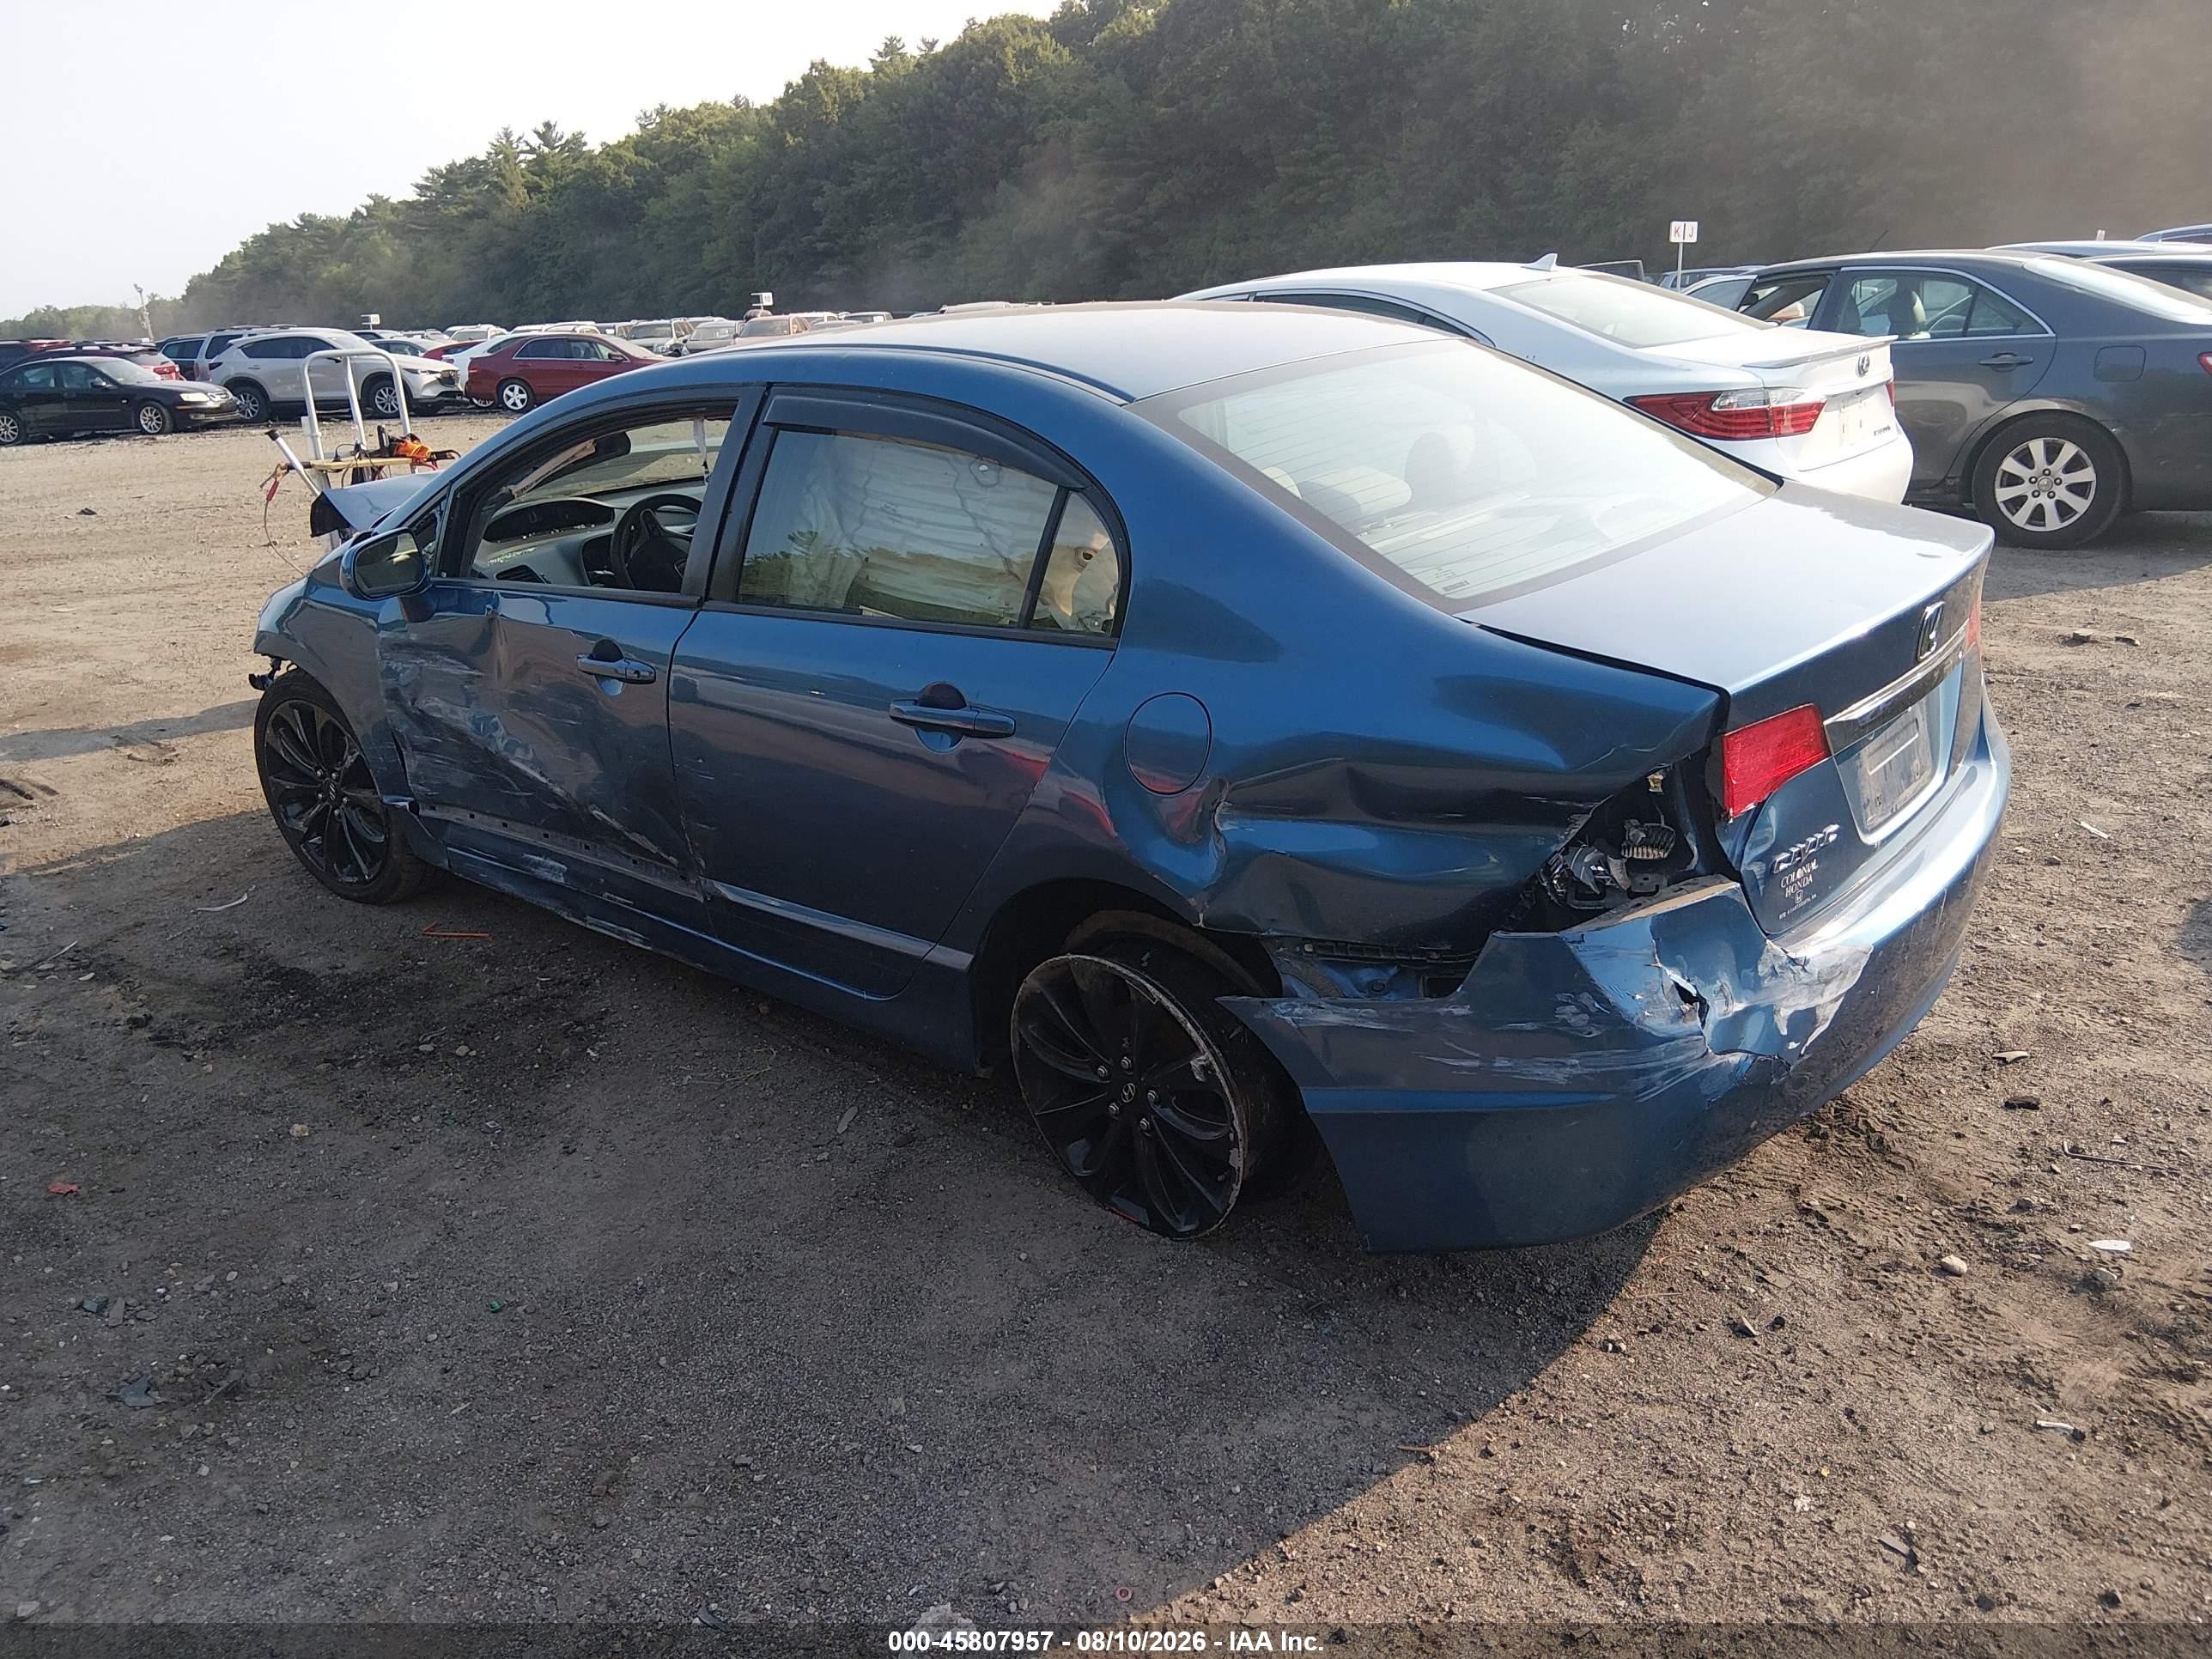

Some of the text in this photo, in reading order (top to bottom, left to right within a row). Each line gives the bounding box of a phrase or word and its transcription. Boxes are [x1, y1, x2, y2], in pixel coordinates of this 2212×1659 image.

[1674, 226, 1694, 238] K J
[1785, 873, 1814, 898] HONDA
